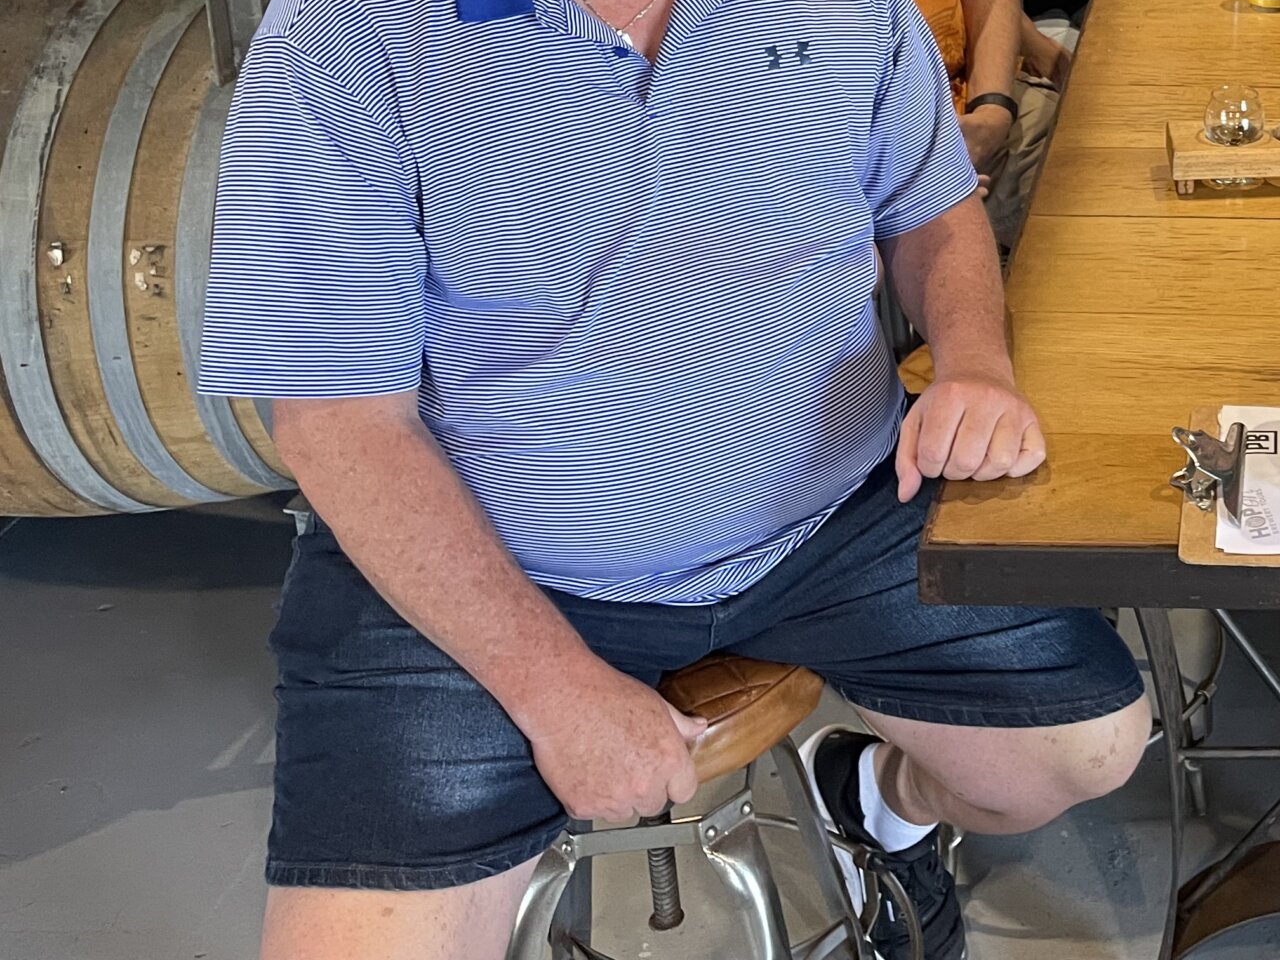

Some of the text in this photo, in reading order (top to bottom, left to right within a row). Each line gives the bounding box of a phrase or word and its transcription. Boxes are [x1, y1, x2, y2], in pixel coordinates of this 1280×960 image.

[1246, 434, 1269, 450] PB
[1242, 507, 1271, 539] HOP
[1263, 506, 1280, 534] BREWERY
